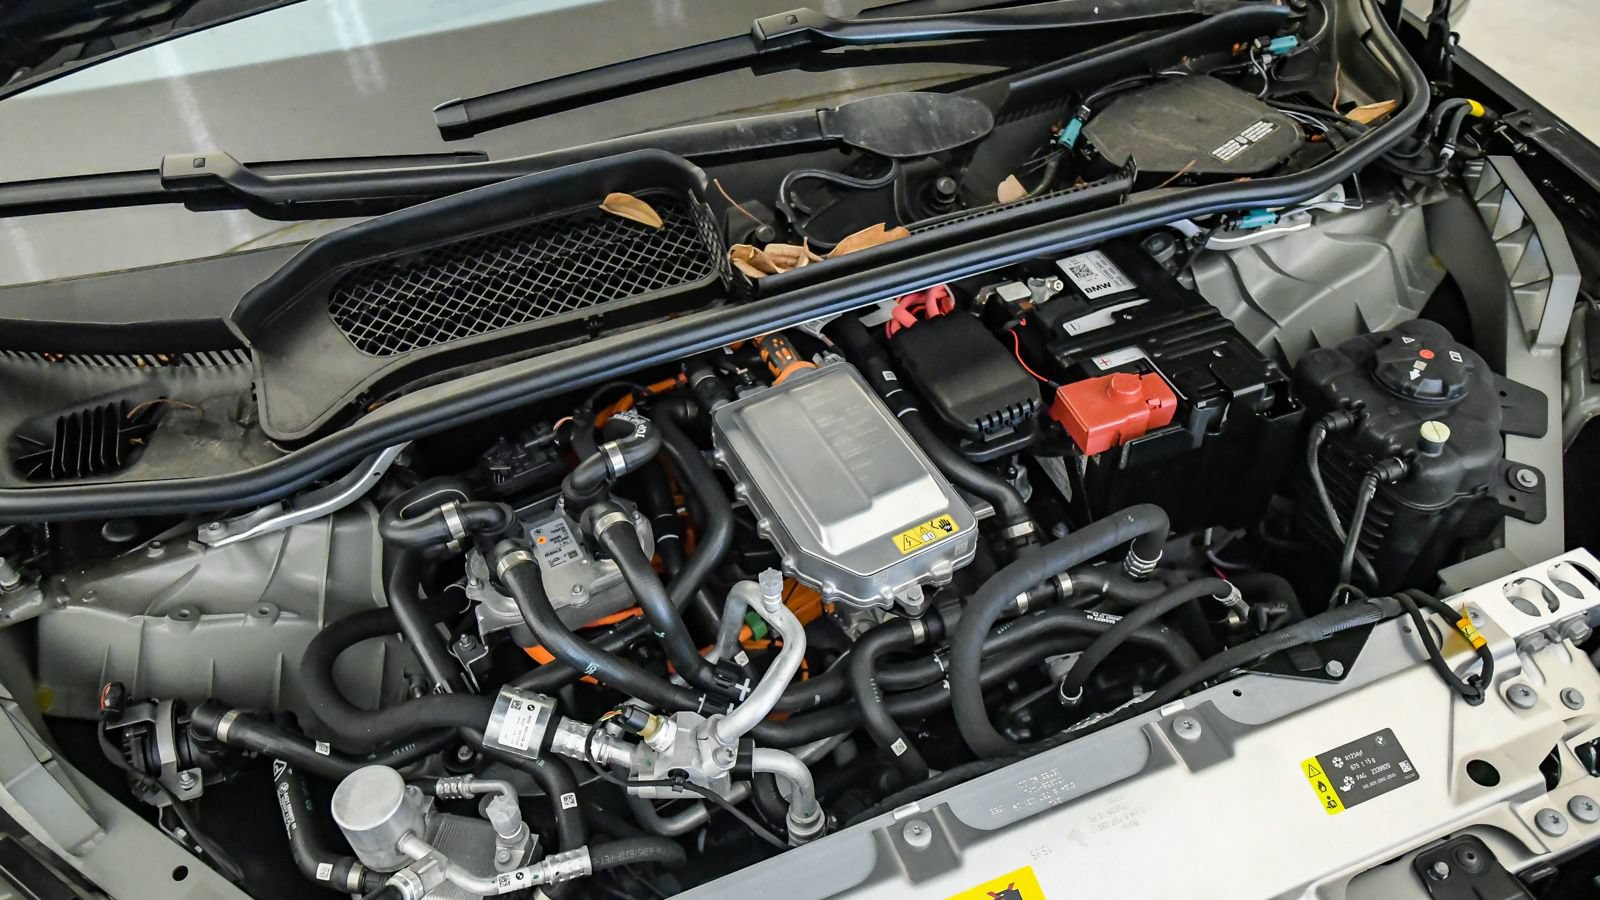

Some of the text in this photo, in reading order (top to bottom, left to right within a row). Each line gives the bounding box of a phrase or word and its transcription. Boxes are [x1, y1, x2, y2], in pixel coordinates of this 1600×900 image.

[1084, 281, 1112, 294] BMW
[635, 424, 647, 438] TOP
[1350, 762, 1360, 771] 675
[1355, 772, 1367, 781] PAG
